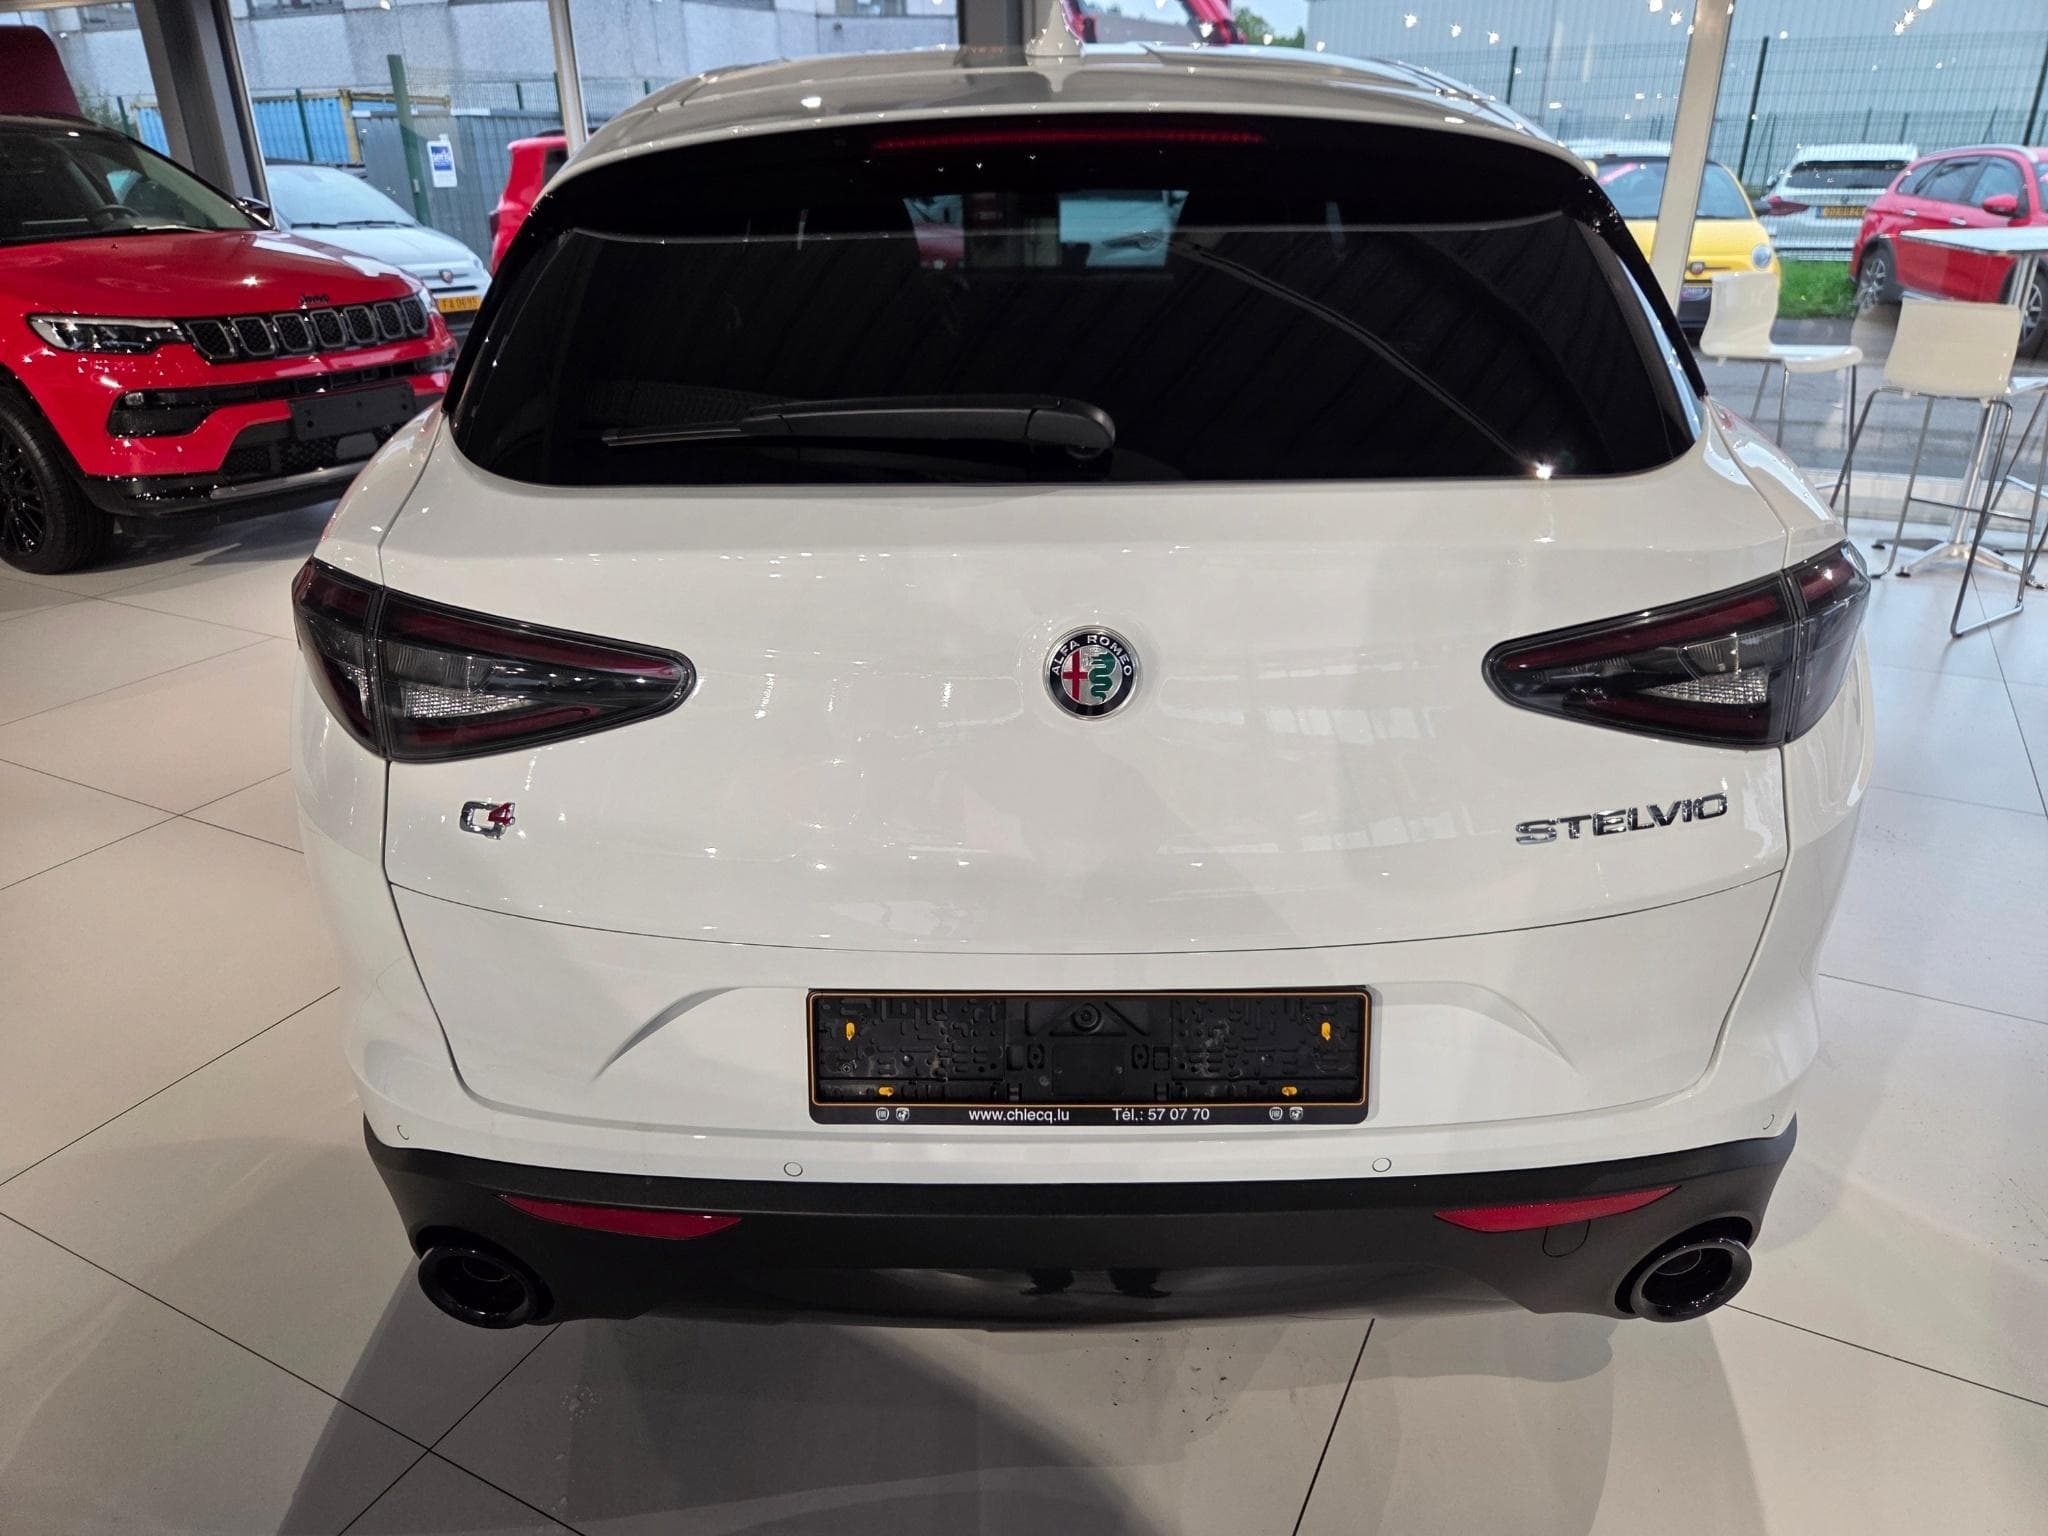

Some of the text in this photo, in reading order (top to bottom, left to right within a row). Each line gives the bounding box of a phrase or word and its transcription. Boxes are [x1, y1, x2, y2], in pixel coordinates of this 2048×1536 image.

[1051, 634, 1132, 676] ALFA ROMEO
[1515, 792, 1728, 845] STELVIO
[968, 1107, 1070, 1125] www.chlecq.lu
[1147, 1107, 1166, 1121] 57
[1169, 1107, 1188, 1121] 07
[1192, 1107, 1211, 1121] 70
